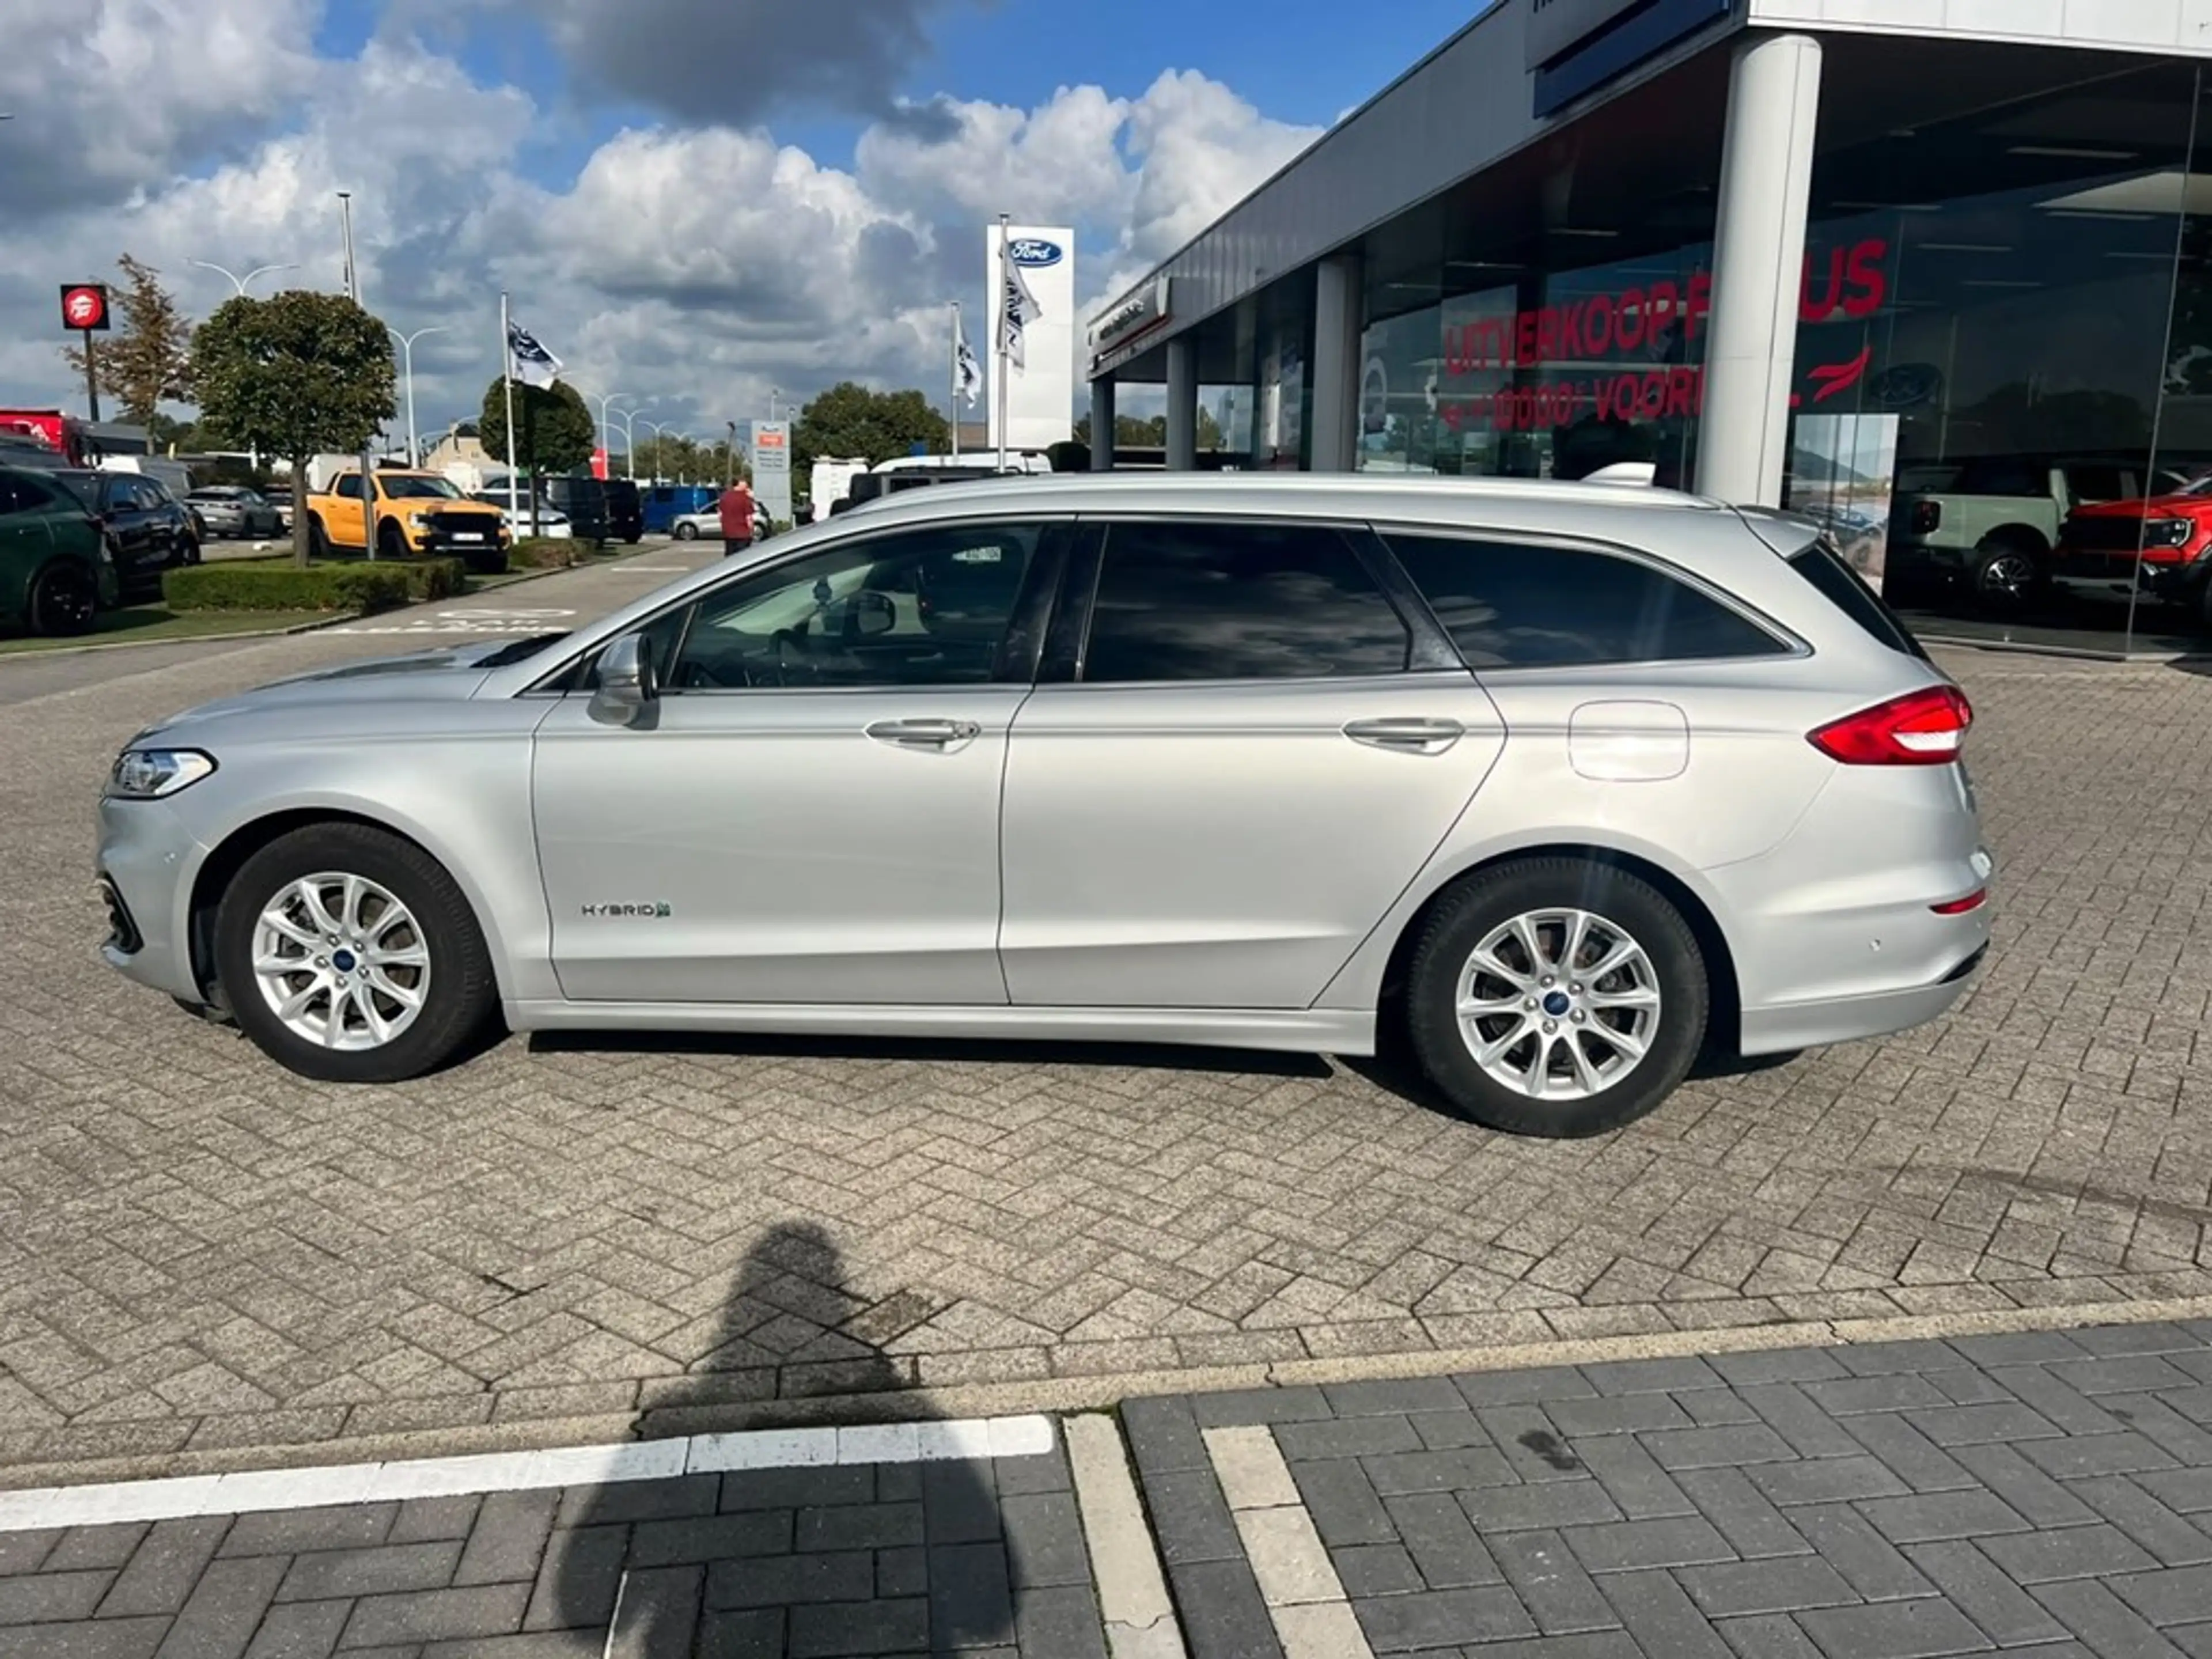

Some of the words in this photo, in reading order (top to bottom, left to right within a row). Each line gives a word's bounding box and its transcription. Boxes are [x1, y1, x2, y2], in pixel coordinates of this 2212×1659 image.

[1011, 242, 1051, 259] Ford
[1445, 280, 1679, 377] UITVERKOOP
[581, 904, 655, 917] HYBRID
